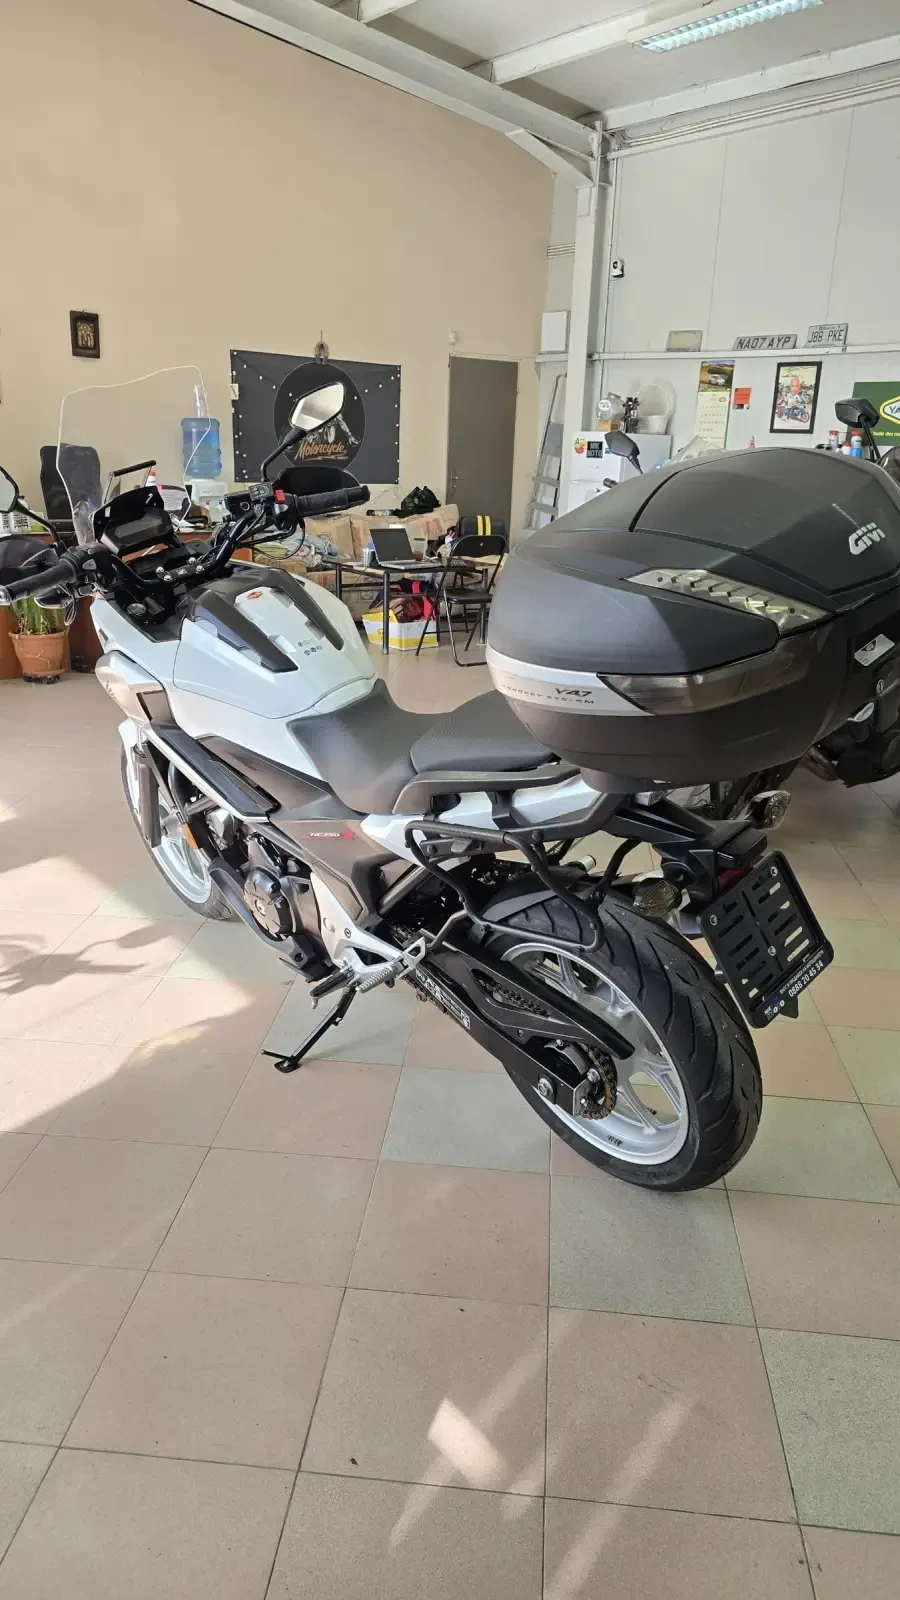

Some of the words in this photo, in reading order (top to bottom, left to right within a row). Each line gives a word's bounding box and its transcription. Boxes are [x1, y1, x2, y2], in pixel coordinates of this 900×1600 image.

[736, 337, 767, 350] NA07
[767, 336, 791, 348] AYP
[827, 329, 845, 342] PKE
[294, 439, 346, 460] Motorcycle
[848, 522, 886, 555] GIVI
[555, 688, 593, 697] V47
[788, 980, 803, 997] 0888
[801, 974, 810, 985] 20
[808, 966, 817, 977] 45
[815, 960, 824, 971] 34
